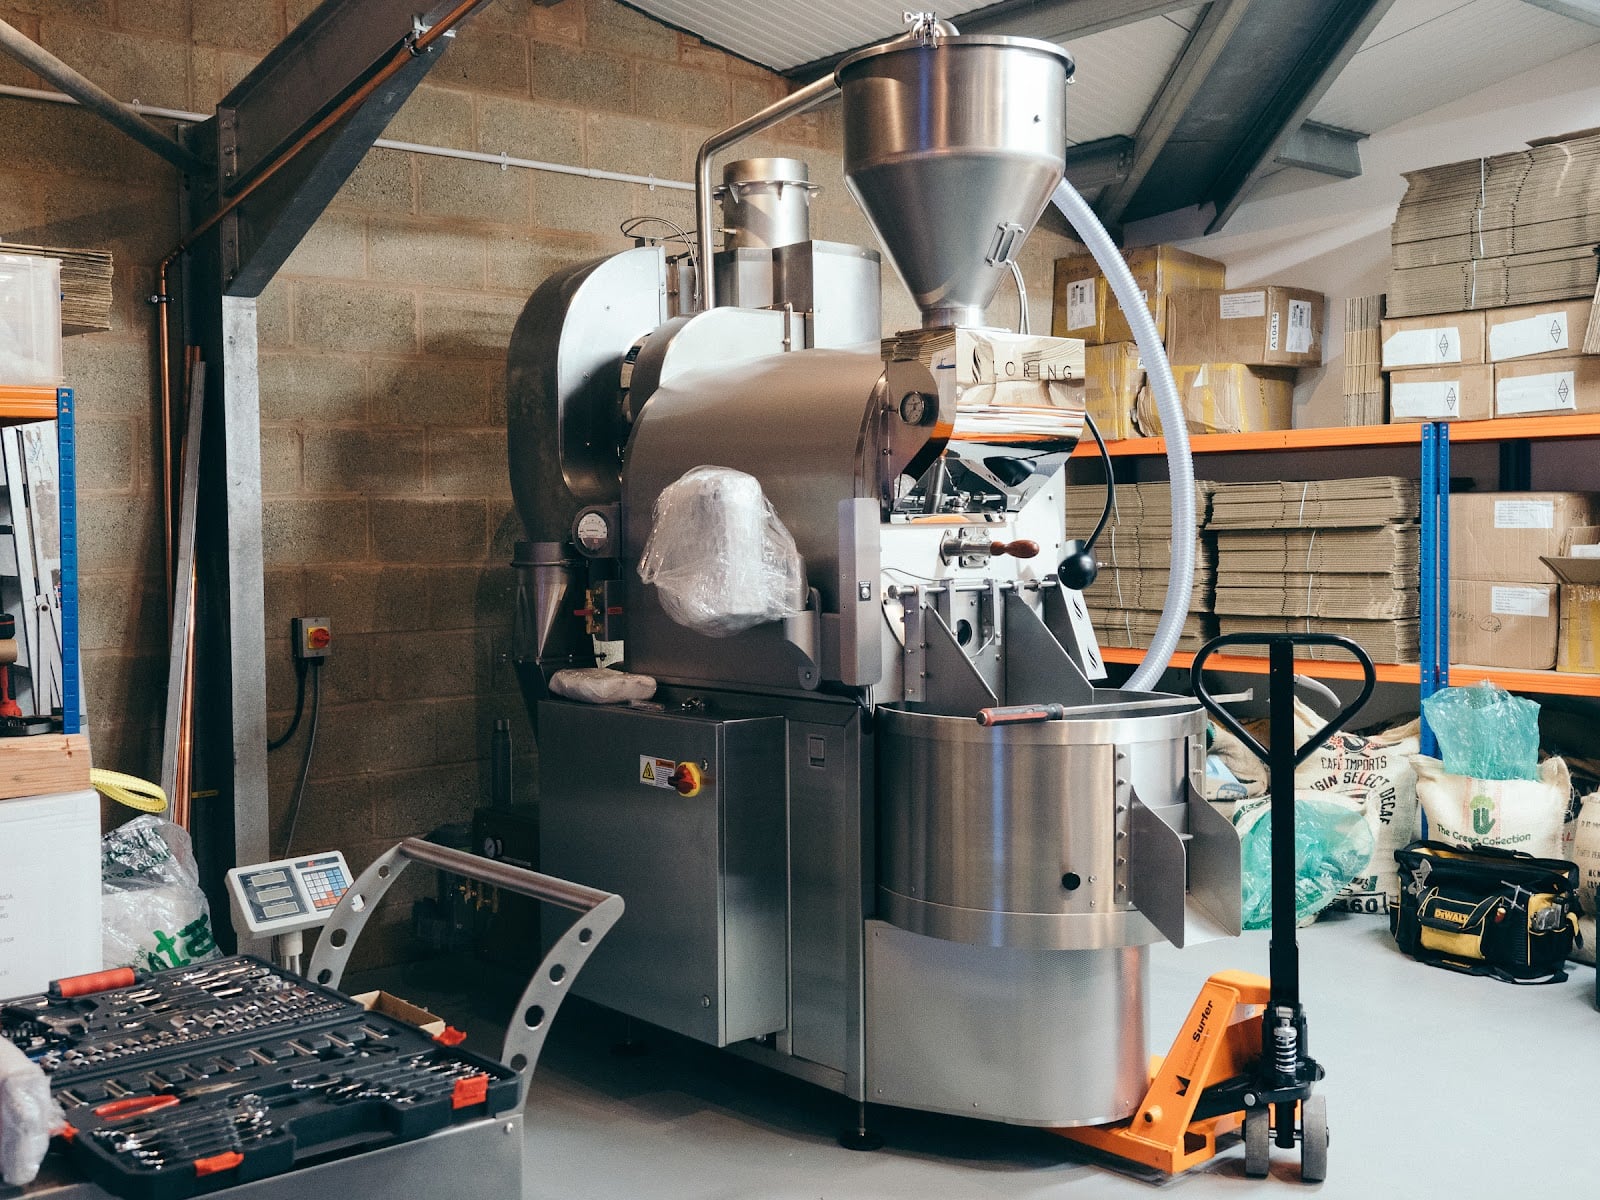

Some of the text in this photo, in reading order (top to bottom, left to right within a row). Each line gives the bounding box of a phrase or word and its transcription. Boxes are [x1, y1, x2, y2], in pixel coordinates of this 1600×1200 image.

[992, 360, 1072, 380] LORING
[1344, 755, 1387, 771] IMPORTS
[1343, 772, 1390, 789] SELECT
[1378, 787, 1396, 825] DECAF
[1436, 823, 1531, 846] The Green Collection
[1192, 1000, 1214, 1042] Surfer
